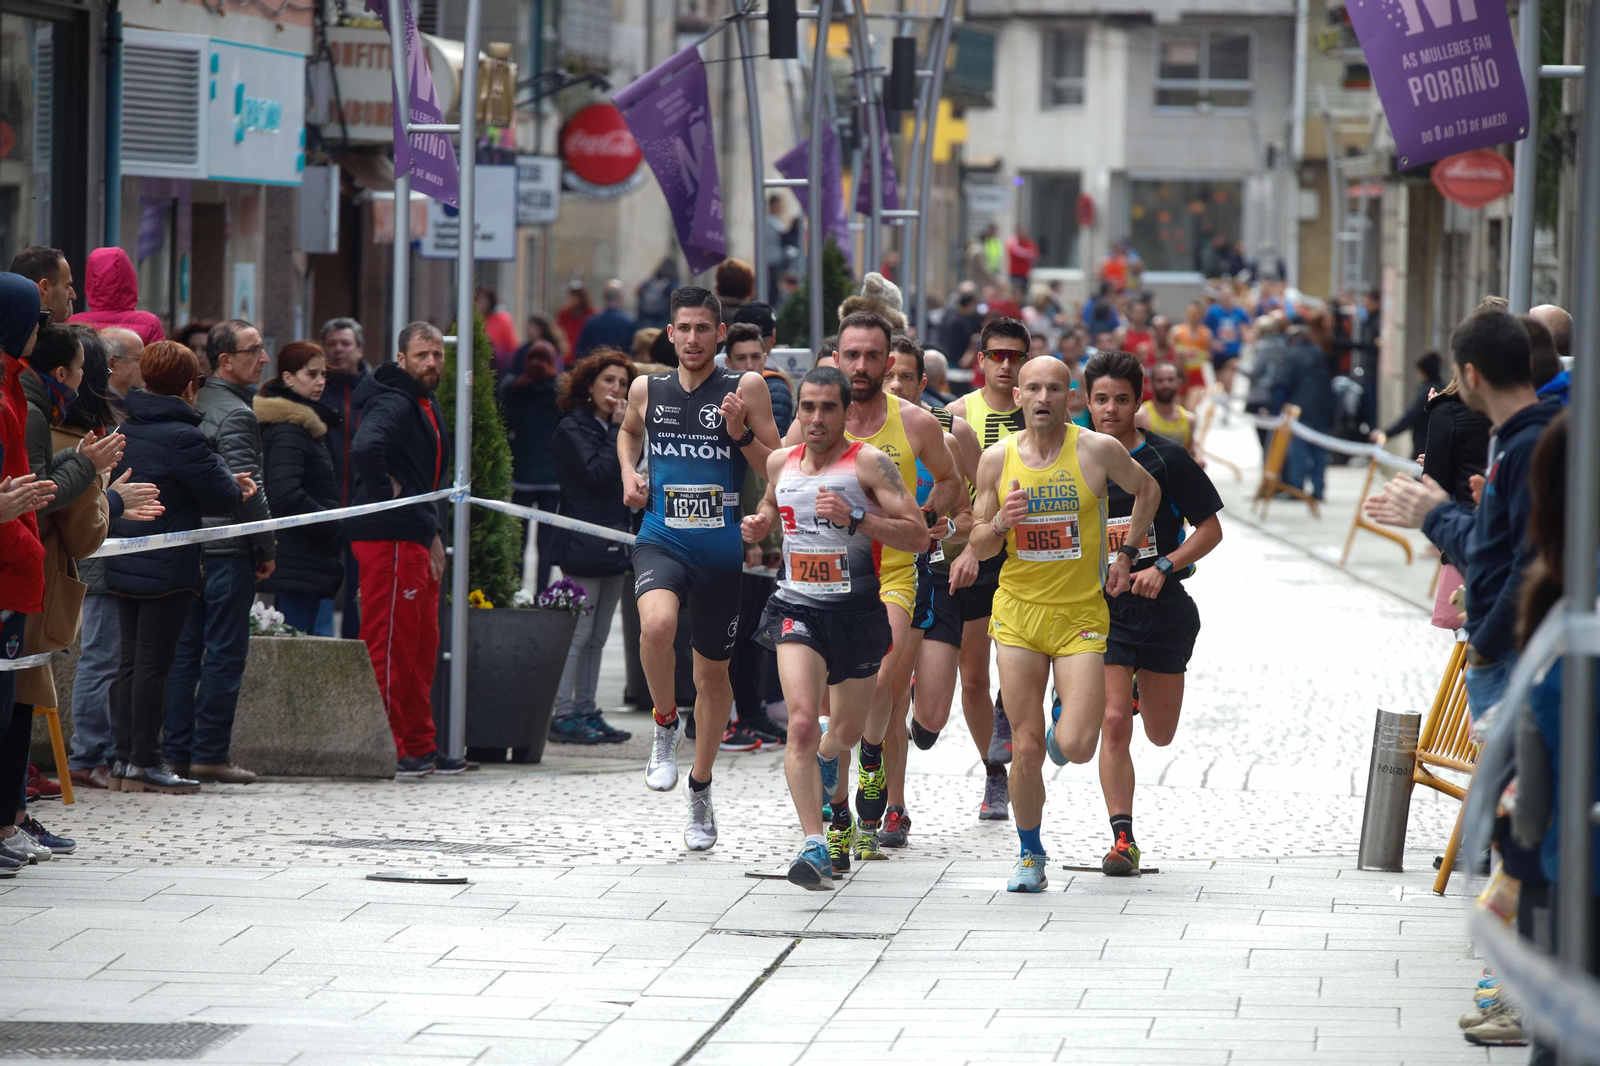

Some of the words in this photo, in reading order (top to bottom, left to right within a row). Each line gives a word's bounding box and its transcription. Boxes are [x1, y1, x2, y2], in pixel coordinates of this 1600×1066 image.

[1402, 52, 1418, 70] AS
[1419, 39, 1472, 66] MULLERES
[1473, 34, 1492, 52] FAN
[1407, 54, 1500, 107] PORRIÑO
[1421, 130, 1433, 144] DO
[1434, 125, 1442, 141] 8
[1444, 125, 1454, 139] AO
[1456, 119, 1468, 136] 13
[1470, 119, 1480, 132] DE
[1482, 112, 1508, 130] MARZO
[650, 442, 730, 460] NARÓN
[673, 498, 710, 518] 1820
[1032, 499, 1079, 513] LÁZARO
[1027, 530, 1060, 550] 965
[800, 561, 830, 581] 249
